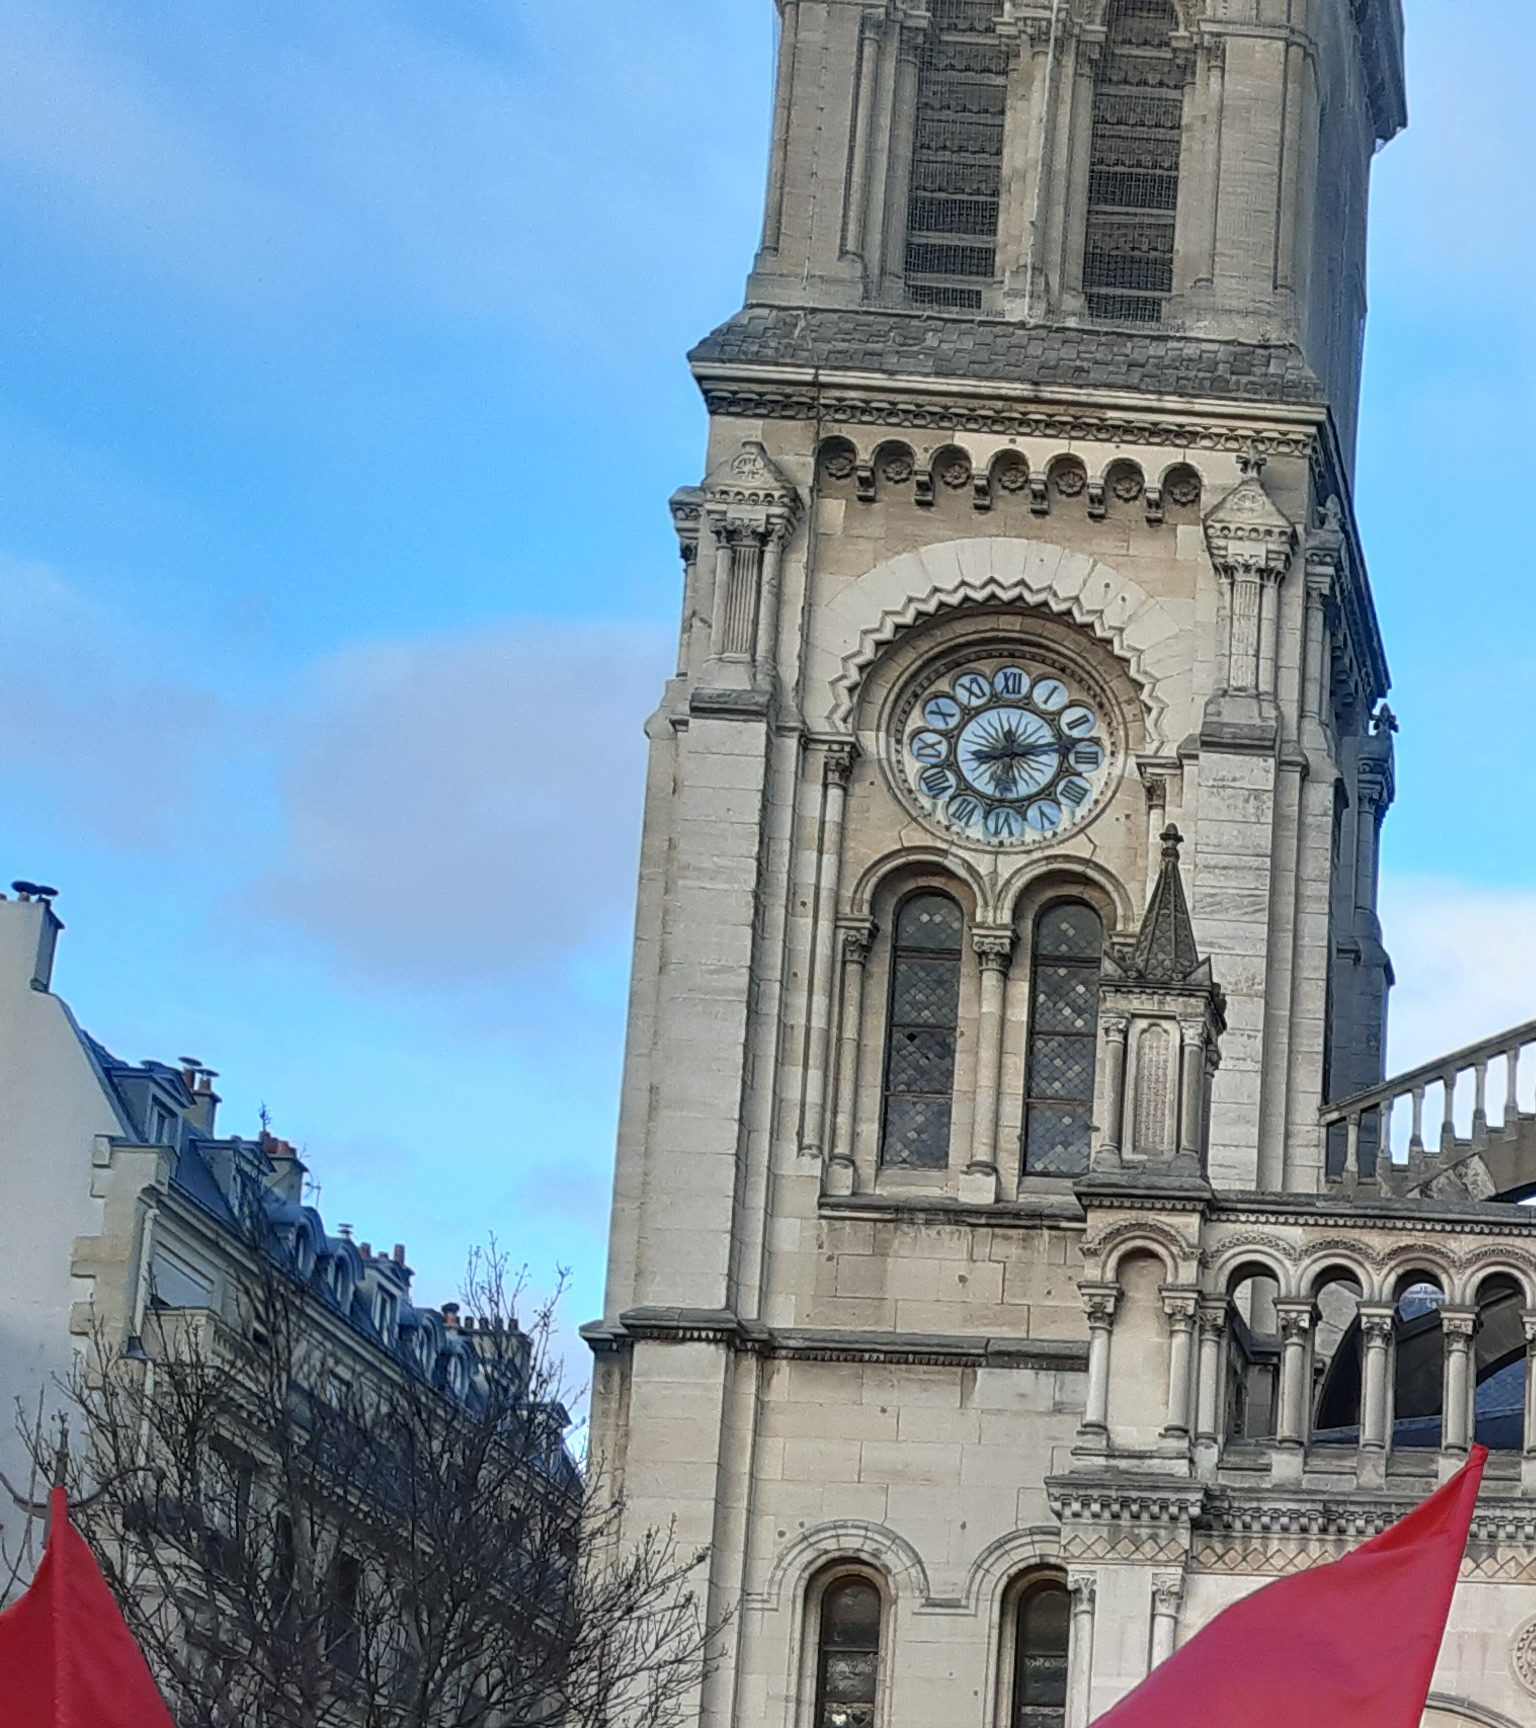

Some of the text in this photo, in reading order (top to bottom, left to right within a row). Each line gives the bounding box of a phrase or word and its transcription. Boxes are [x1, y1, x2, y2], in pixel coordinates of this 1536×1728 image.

[958, 677, 986, 706] XI
[1002, 671, 1022, 695] XII
[1043, 685, 1060, 705] I
[927, 702, 956, 727] X
[1065, 714, 1090, 731] II
[917, 737, 943, 759] IX
[1074, 750, 1099, 766] III
[951, 798, 978, 827] VII
[1038, 805, 1057, 830] V
[993, 813, 1015, 839] VI
